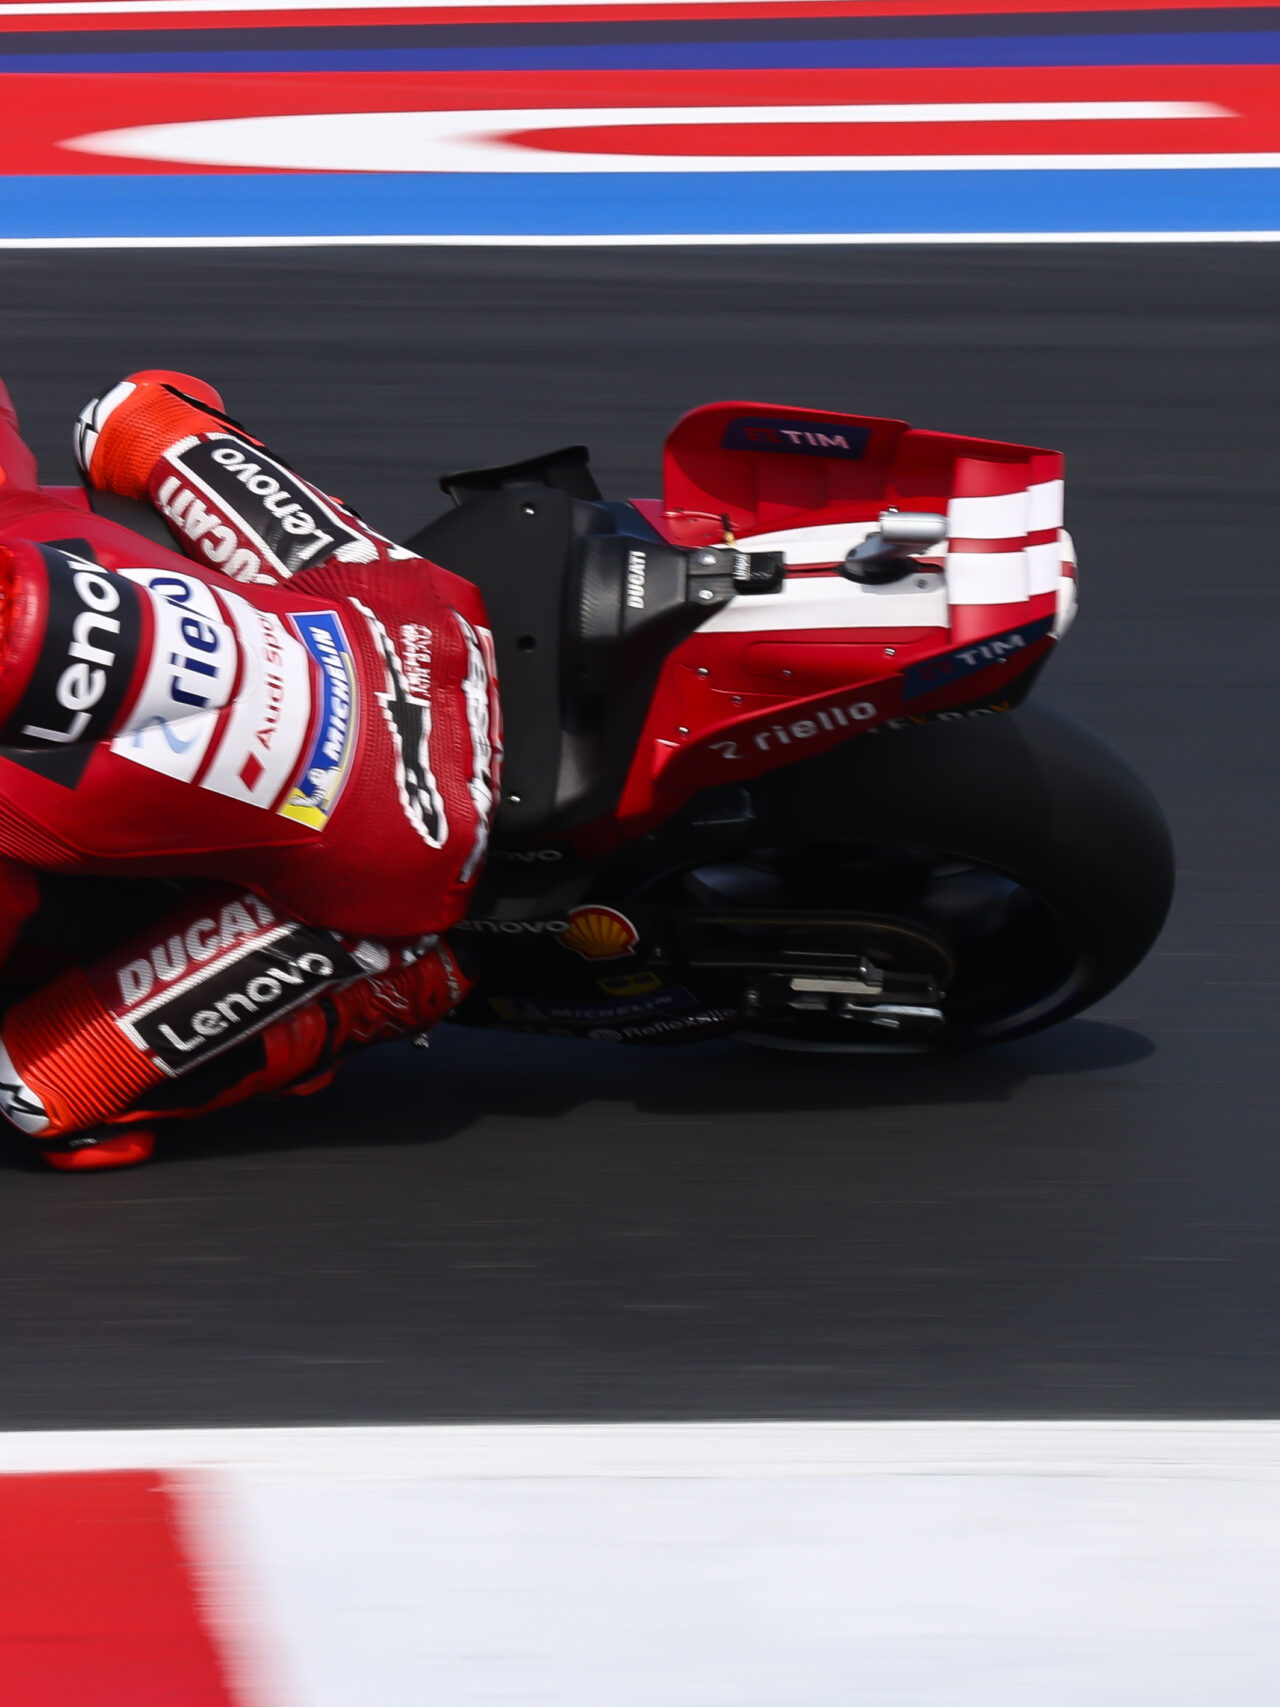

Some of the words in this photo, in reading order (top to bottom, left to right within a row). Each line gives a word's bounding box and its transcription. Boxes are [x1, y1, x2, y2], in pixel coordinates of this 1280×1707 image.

[781, 429, 850, 451] TIM
[211, 447, 335, 572] Lenovo
[626, 550, 646, 609] DUCATI
[20, 549, 121, 743] Lenov
[957, 634, 1027, 666] TIM
[256, 672, 286, 751] Audi
[308, 626, 350, 762] MICHELIN
[753, 702, 878, 752] riello
[117, 894, 276, 1007] DUCAT
[158, 953, 334, 1052] Lenovo
